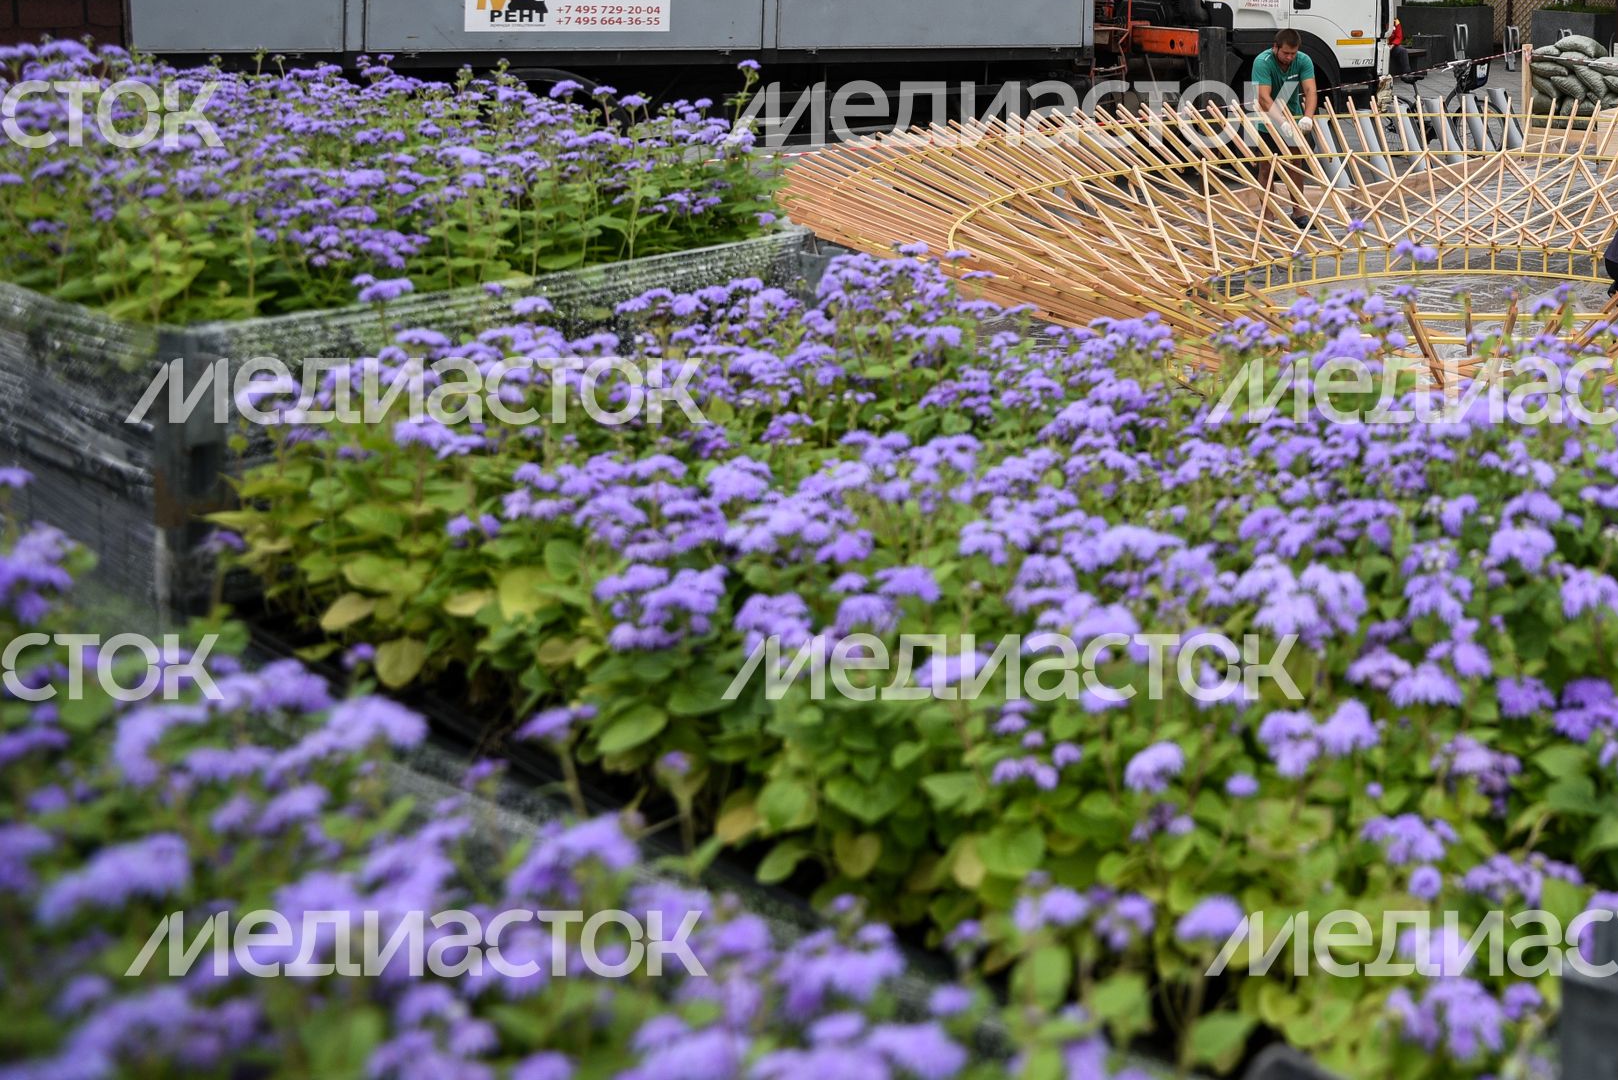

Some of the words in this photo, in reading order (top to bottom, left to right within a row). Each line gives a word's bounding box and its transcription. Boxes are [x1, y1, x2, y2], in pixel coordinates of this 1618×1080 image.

[556, 5, 572, 14] +7
[574, 5, 598, 14] 495
[601, 5, 661, 15] 729-20-04
[490, 10, 546, 23] РЕНТ
[556, 17, 571, 25] +7
[574, 17, 598, 26] 495
[600, 17, 661, 26] 664-36-55
